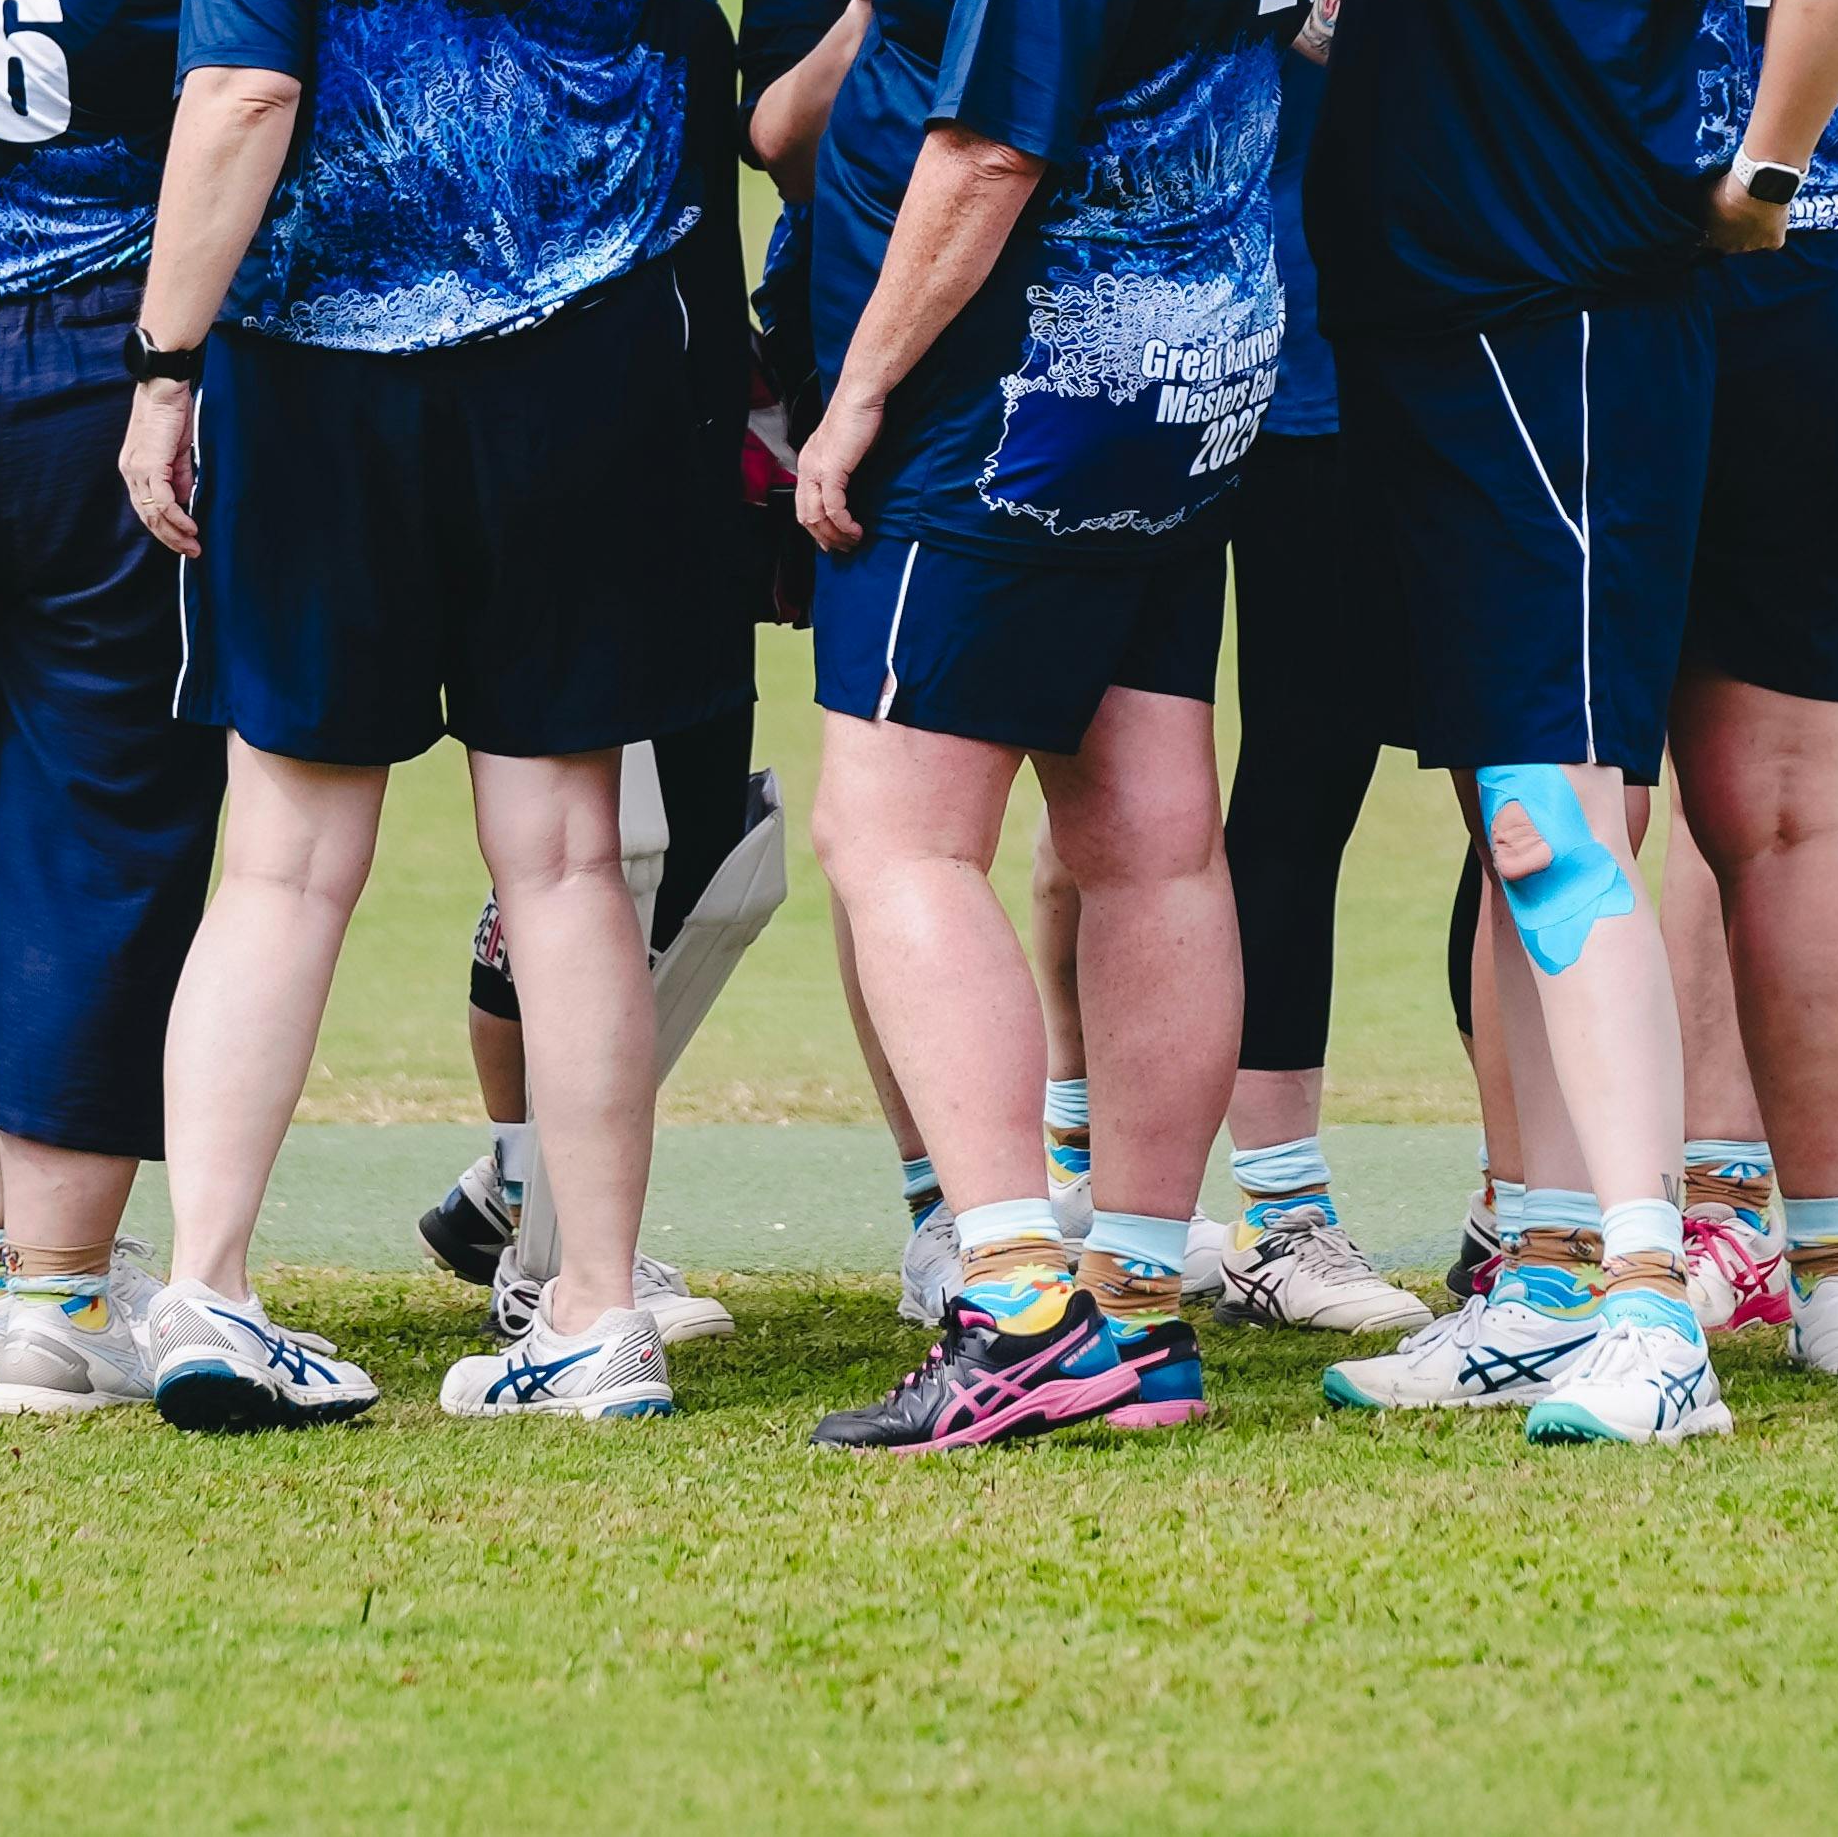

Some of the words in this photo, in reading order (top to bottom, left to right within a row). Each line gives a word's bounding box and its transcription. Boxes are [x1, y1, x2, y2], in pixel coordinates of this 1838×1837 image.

[1141, 338, 1224, 382] Great
[1156, 379, 1250, 424] Masters
[1189, 401, 1269, 477] 2025
